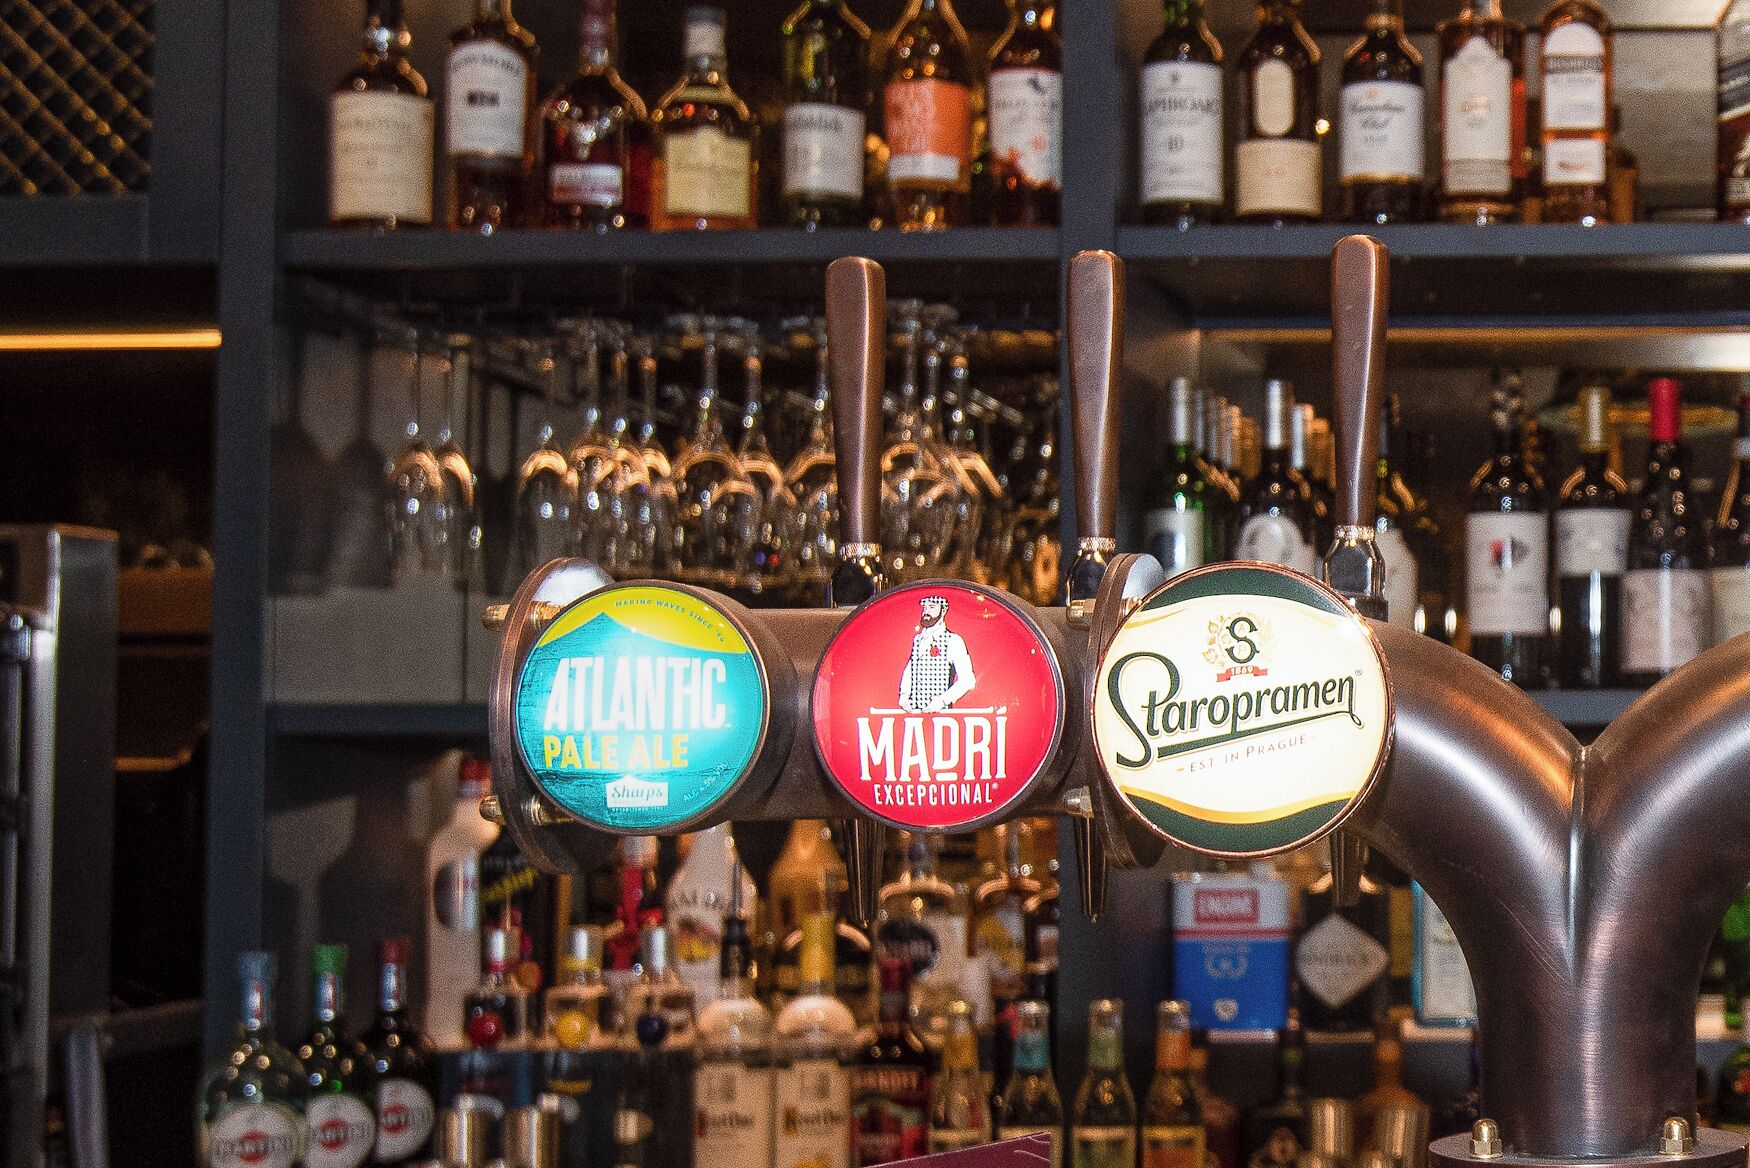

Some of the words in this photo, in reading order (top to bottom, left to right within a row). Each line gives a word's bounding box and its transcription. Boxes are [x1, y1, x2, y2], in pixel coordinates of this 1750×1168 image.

[656, 599, 686, 613] WAVES
[1230, 666, 1255, 676] 1869
[544, 655, 727, 731] ATLANTIC
[1106, 651, 1363, 769] Staropramen
[544, 734, 618, 769] PALE
[627, 734, 689, 769] ALE
[1225, 752, 1239, 763] IN
[874, 783, 993, 806] EXCEPCIONAL
